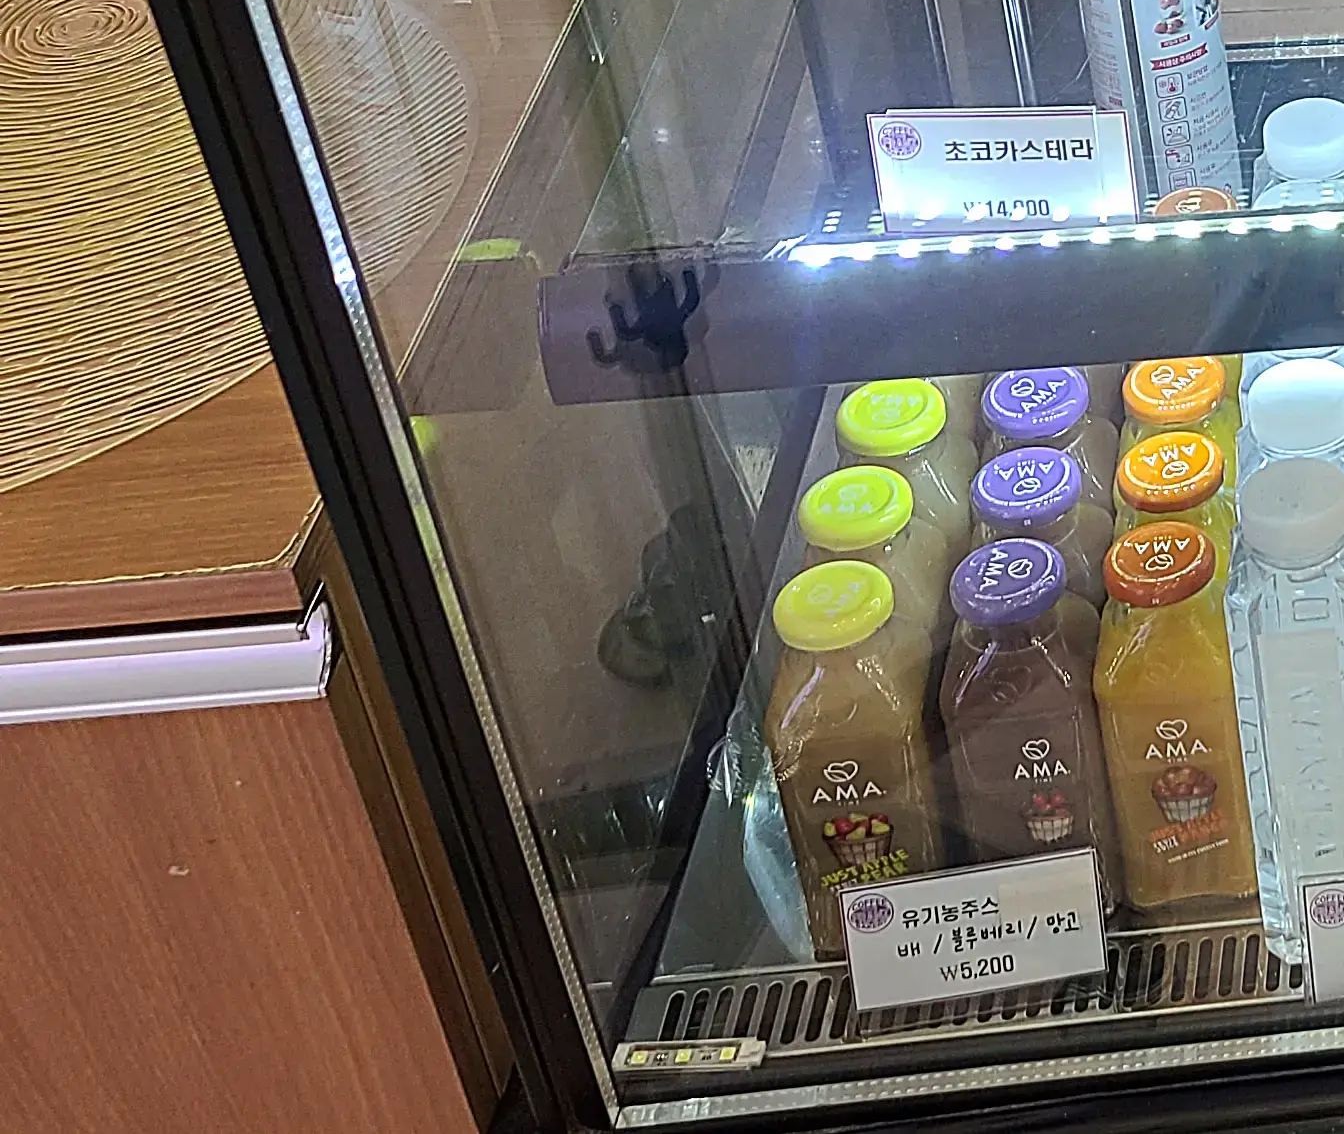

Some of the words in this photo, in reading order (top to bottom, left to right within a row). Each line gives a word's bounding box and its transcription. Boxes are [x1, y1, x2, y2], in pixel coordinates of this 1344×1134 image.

[945, 139, 1094, 161] 초코카스테라
[1161, 366, 1205, 399] AMA
[1021, 379, 1067, 413] AMA
[1142, 442, 1196, 466] AMA
[998, 460, 1054, 481] AMA
[1134, 537, 1191, 556] AMA
[979, 547, 1009, 591] AMA
[1145, 739, 1208, 760] AMA
[1014, 759, 1068, 780] AMA
[812, 781, 882, 804] AMA
[902, 897, 1000, 929] 유기농주스
[897, 944, 921, 957] 배
[1046, 912, 1080, 934] 망고
[940, 954, 1016, 983] ₩5,200
